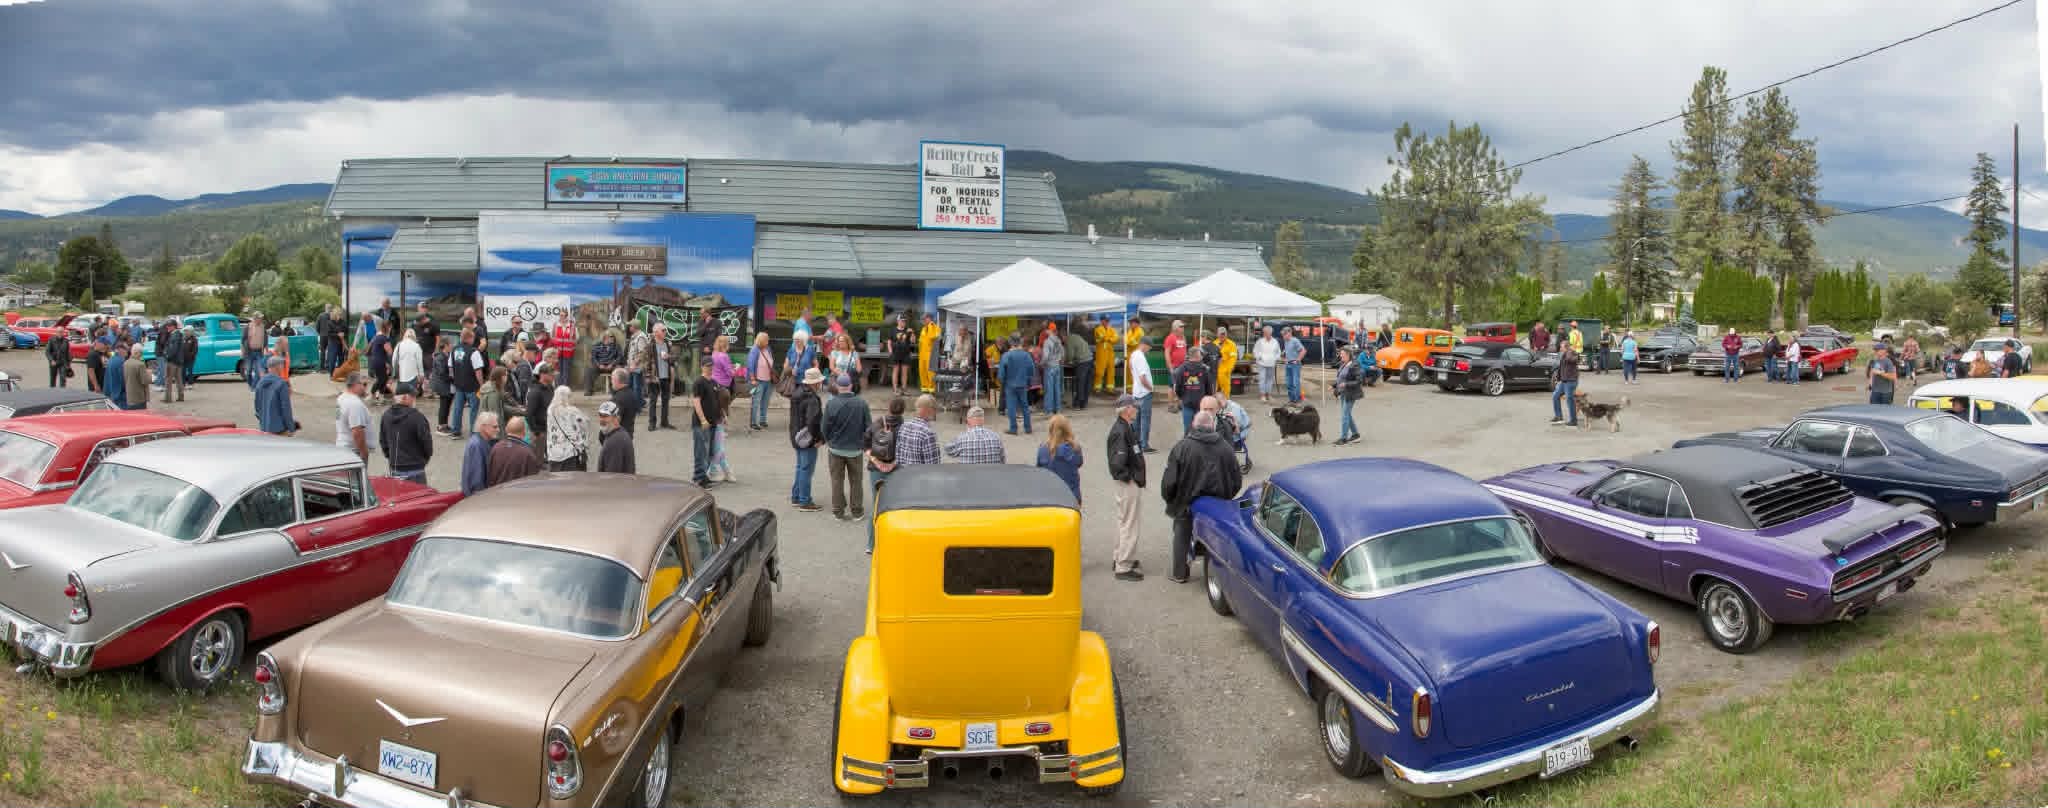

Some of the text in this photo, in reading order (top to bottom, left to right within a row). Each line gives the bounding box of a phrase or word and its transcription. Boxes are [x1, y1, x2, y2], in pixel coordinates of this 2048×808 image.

[951, 163, 974, 177] Hall
[930, 186, 1000, 198] FOR INQUIRIES
[940, 196, 992, 207] OR RENTAL
[936, 205, 990, 216] INFO CALL
